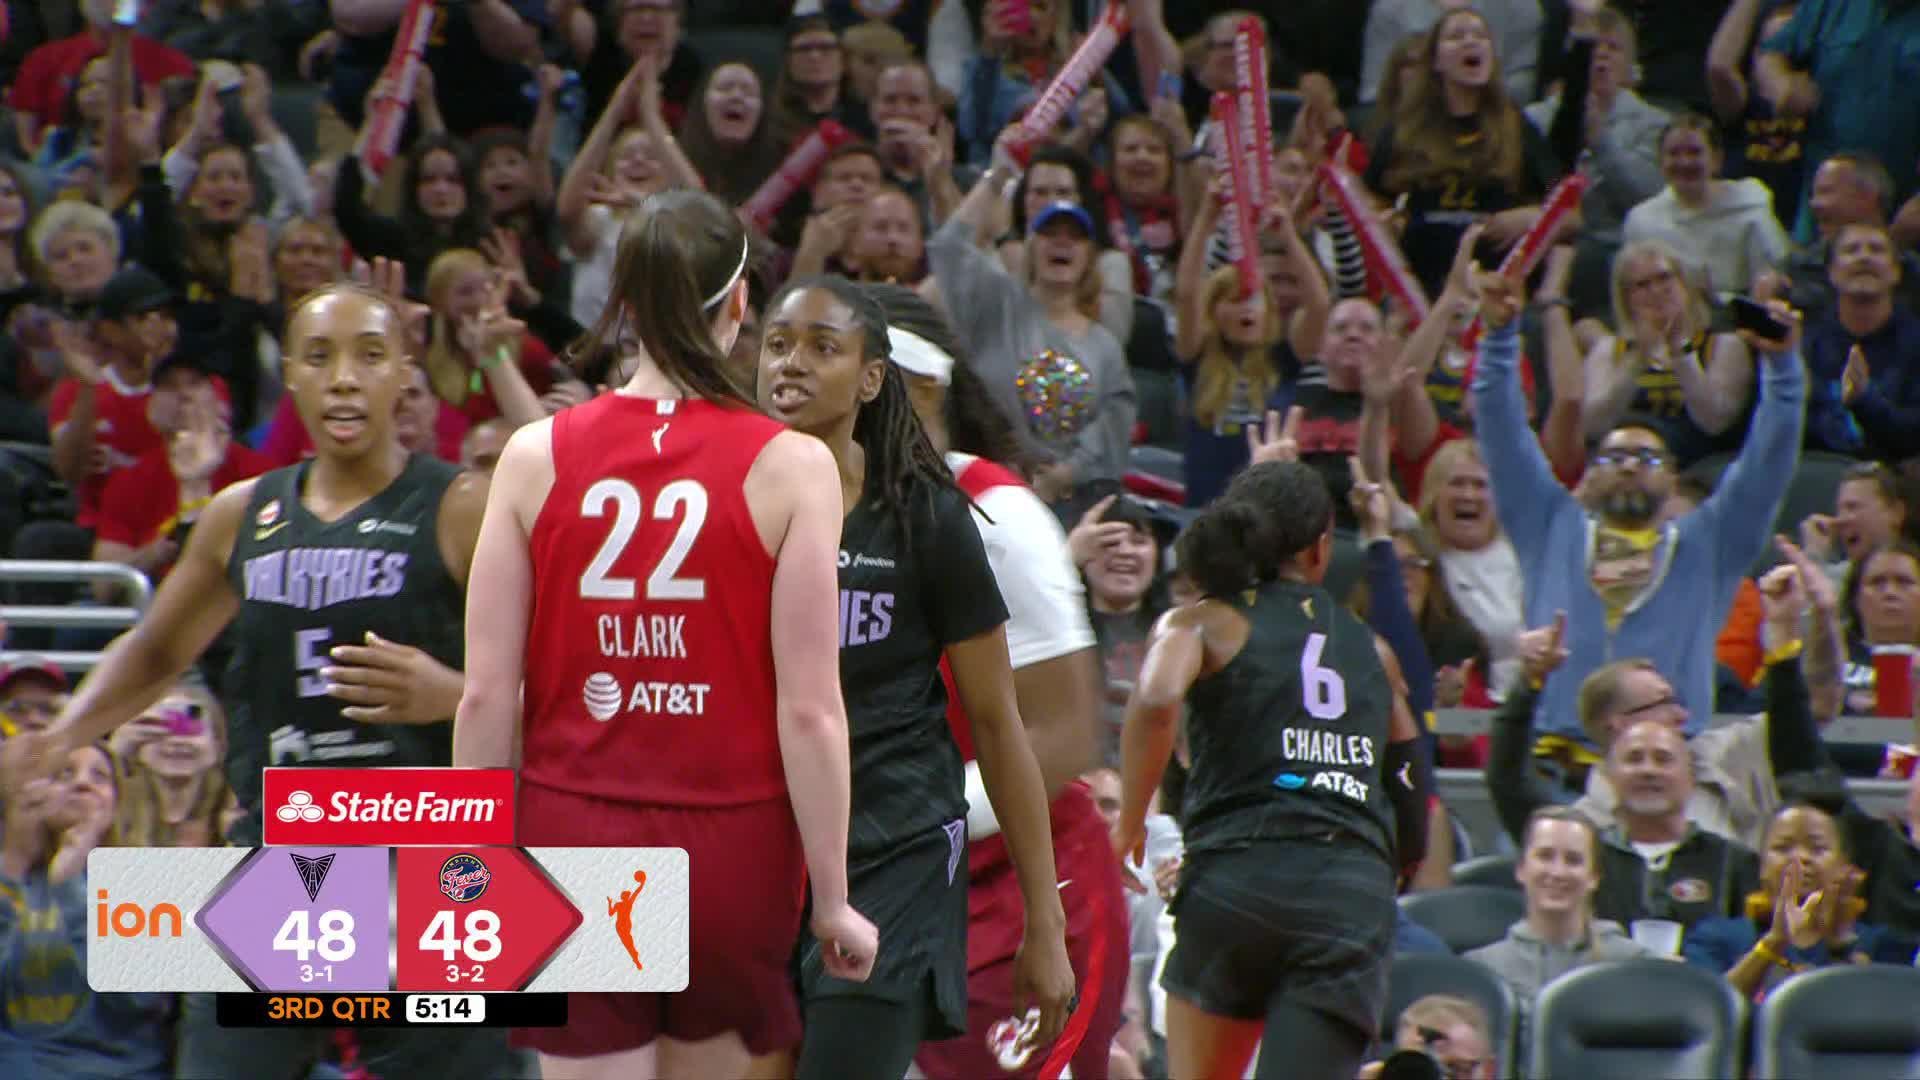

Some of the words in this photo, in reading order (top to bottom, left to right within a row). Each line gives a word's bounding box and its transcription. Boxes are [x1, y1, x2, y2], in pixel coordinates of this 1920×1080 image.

[579, 477, 709, 600] 22
[853, 552, 896, 569] freedom
[243, 547, 410, 611] VALKYRIES
[598, 614, 687, 659] CLARK
[295, 627, 333, 698] 5
[1301, 632, 1347, 720] 6
[628, 681, 711, 716] AT&T
[1282, 727, 1375, 767] CHARLES
[1311, 771, 1369, 803] AT&T
